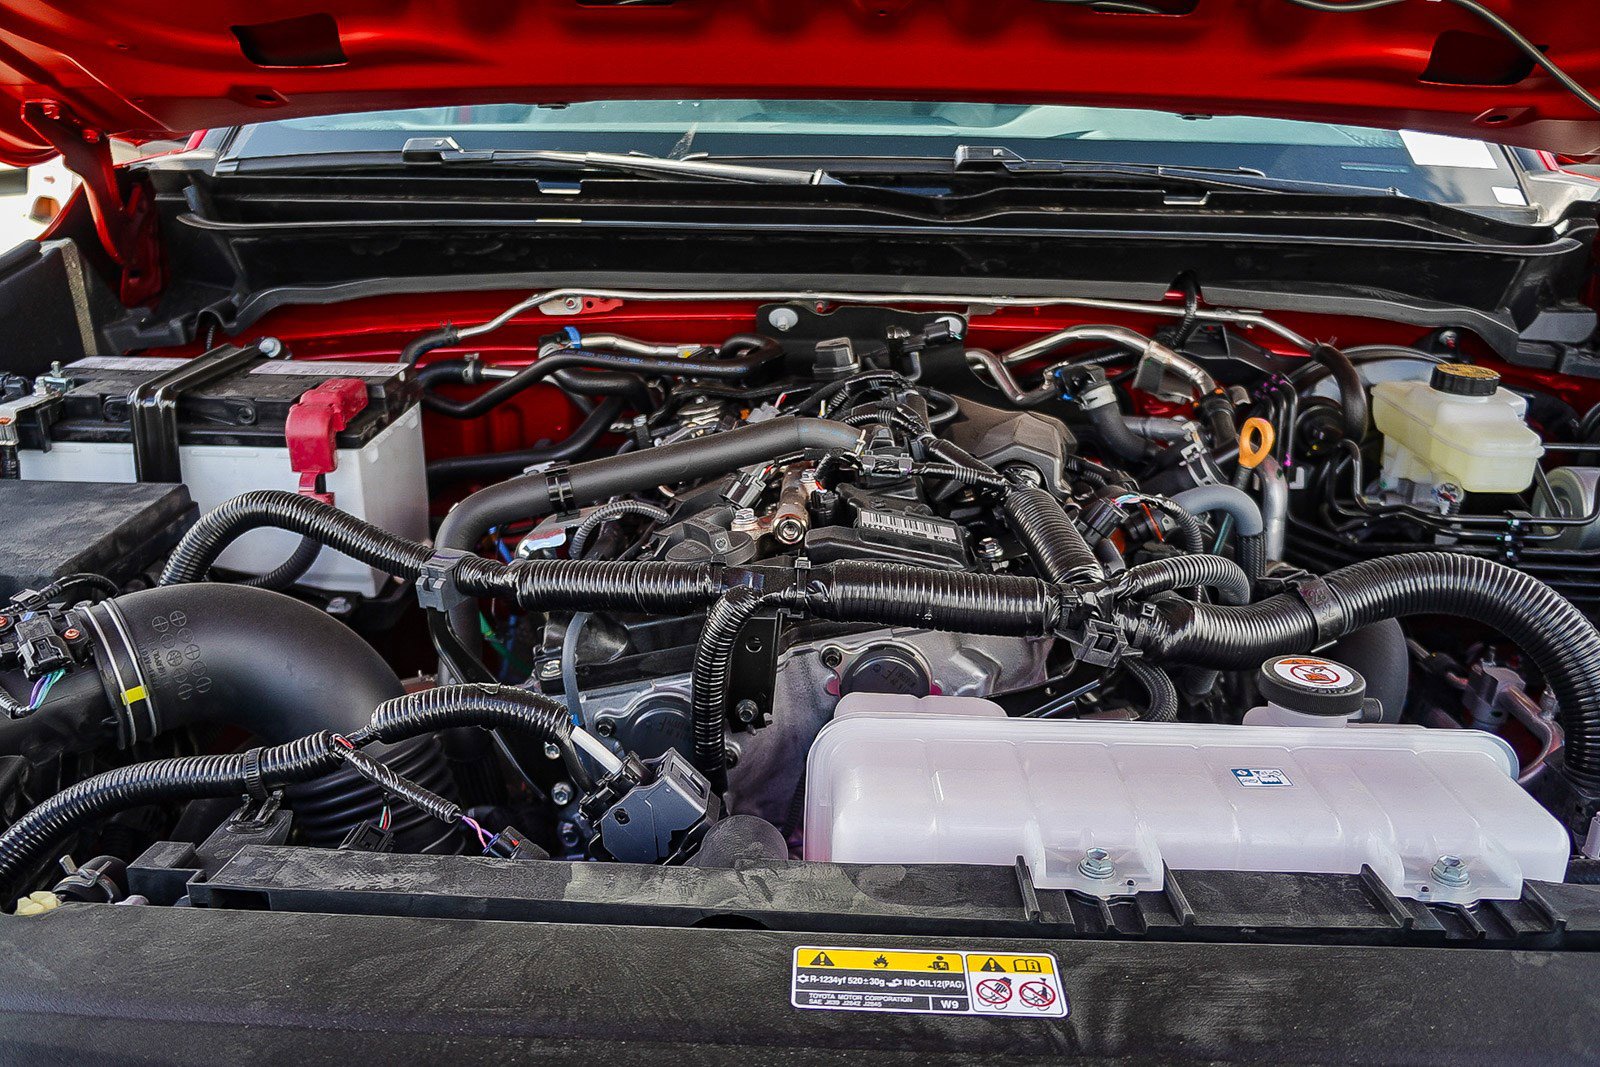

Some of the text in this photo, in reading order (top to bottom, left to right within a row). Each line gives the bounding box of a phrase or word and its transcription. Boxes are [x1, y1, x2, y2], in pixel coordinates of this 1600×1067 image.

[809, 976, 965, 990] R-1234yf 520±30g ND-OIL12(PAG)
[809, 992, 835, 1000] TOYOTA
[865, 995, 913, 1003] CORPORATION
[940, 1000, 959, 1009] W9
